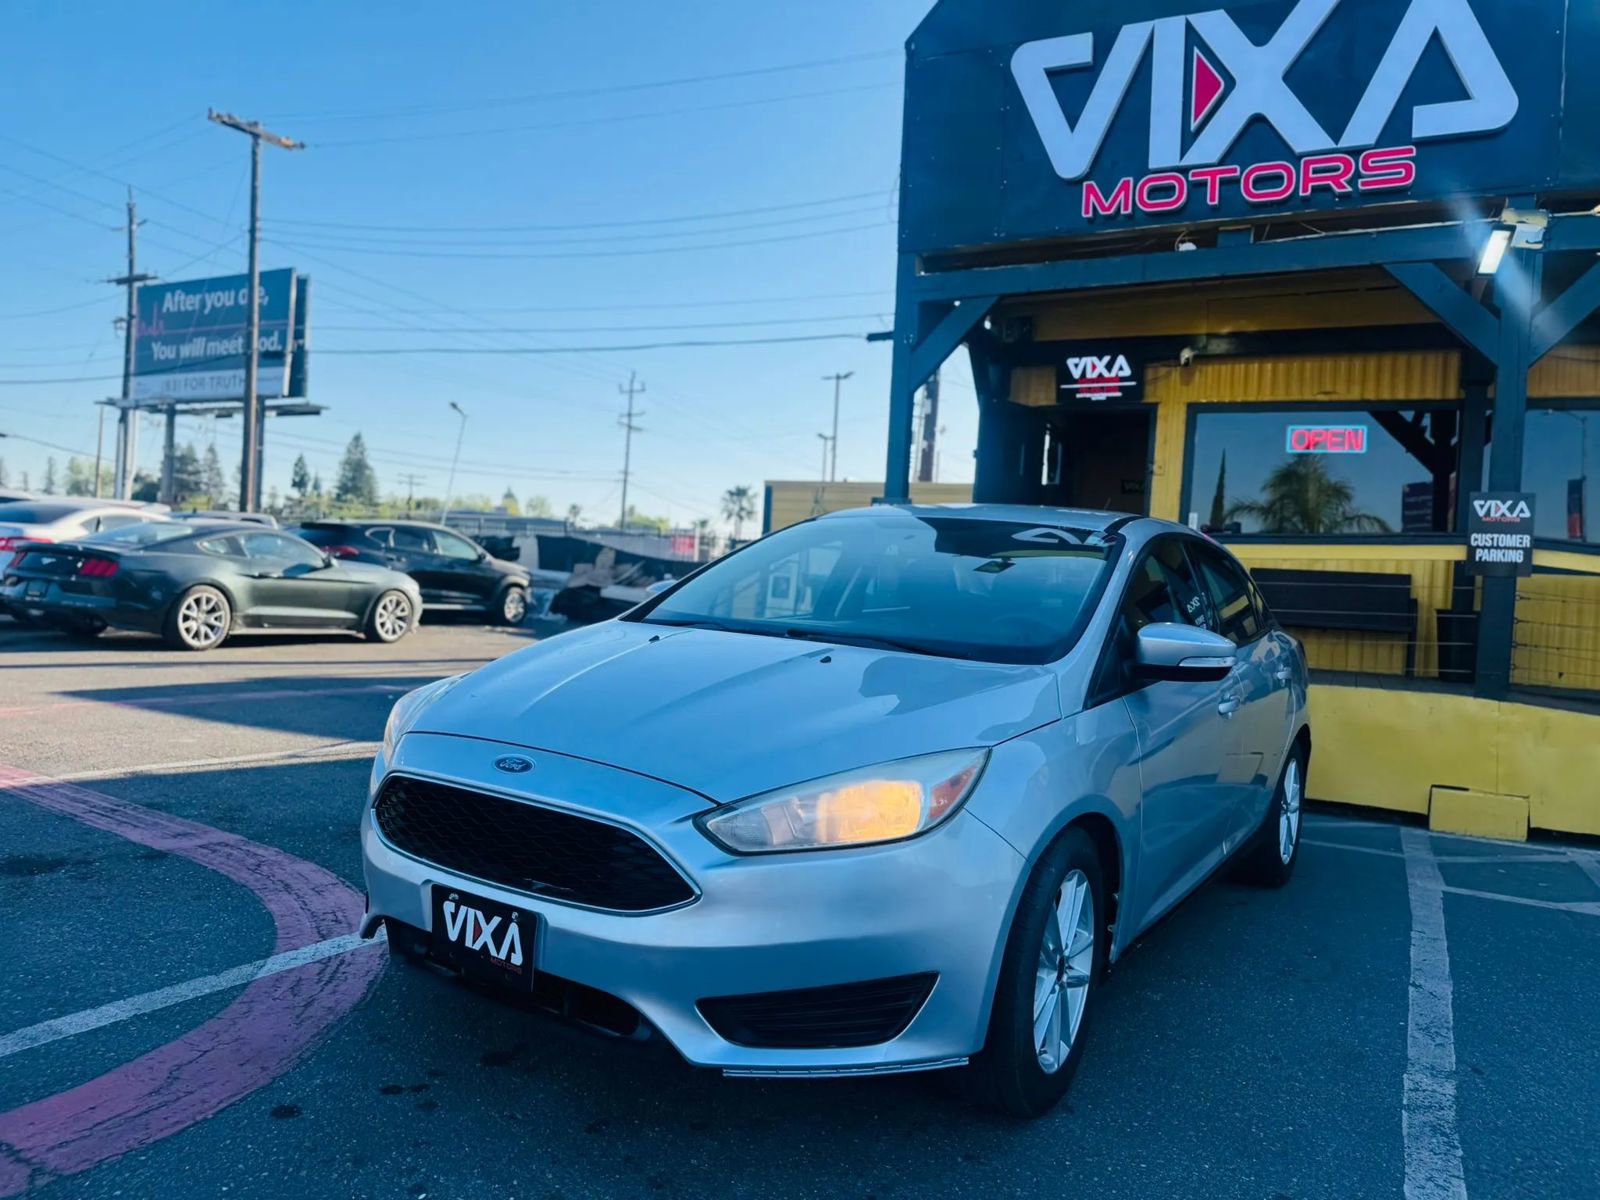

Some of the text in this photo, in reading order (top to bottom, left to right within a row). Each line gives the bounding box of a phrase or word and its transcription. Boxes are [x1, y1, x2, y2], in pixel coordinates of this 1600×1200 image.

[1010, 0, 1519, 180] VIXA
[1081, 145, 1417, 218] MOTORS
[162, 289, 201, 313] After
[203, 290, 236, 314] you
[151, 330, 283, 360] You will meet od.
[1066, 354, 1132, 379] VIXA
[1291, 429, 1363, 452] OPEN
[1473, 499, 1532, 518] VIXA
[1470, 533, 1531, 548] CUSTOMER
[1475, 548, 1524, 563] PARKING
[443, 900, 523, 966] VIXA
